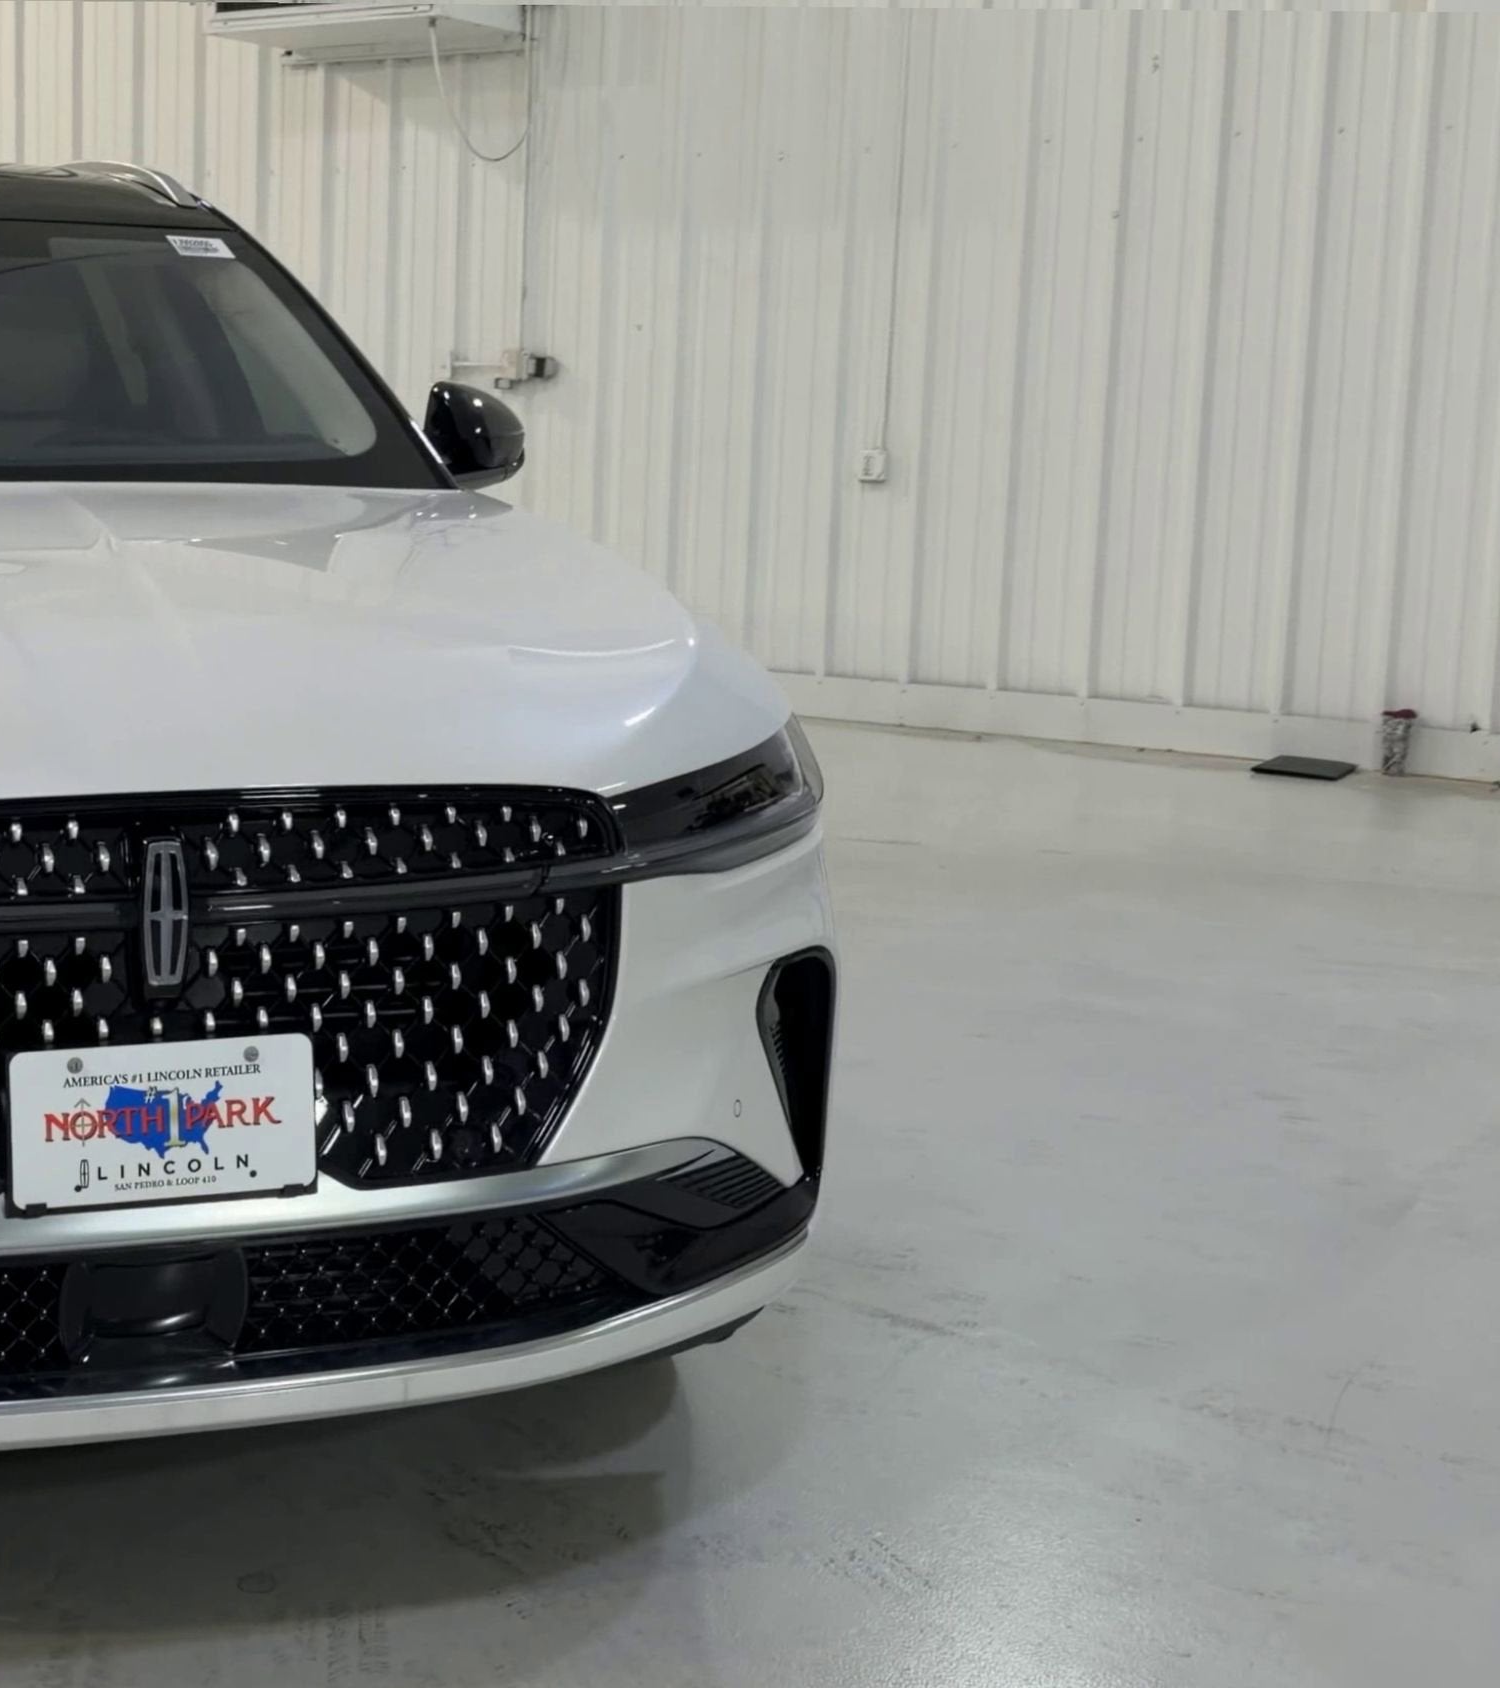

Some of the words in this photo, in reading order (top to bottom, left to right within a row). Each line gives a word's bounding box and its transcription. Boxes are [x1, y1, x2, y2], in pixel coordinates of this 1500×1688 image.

[63, 1073, 129, 1088] AMERICA'S
[131, 1072, 144, 1084] #1
[147, 1068, 202, 1082] LINCOLN
[205, 1063, 261, 1078] RETAILER
[44, 1105, 165, 1142] NORTH
[185, 1096, 282, 1130] PARK
[97, 1154, 248, 1180] LINCOLN
[114, 1180, 132, 1191] SAN
[134, 1178, 165, 1190] PEDRO
[175, 1176, 200, 1186] LOOP
[202, 1175, 217, 1184] 410
